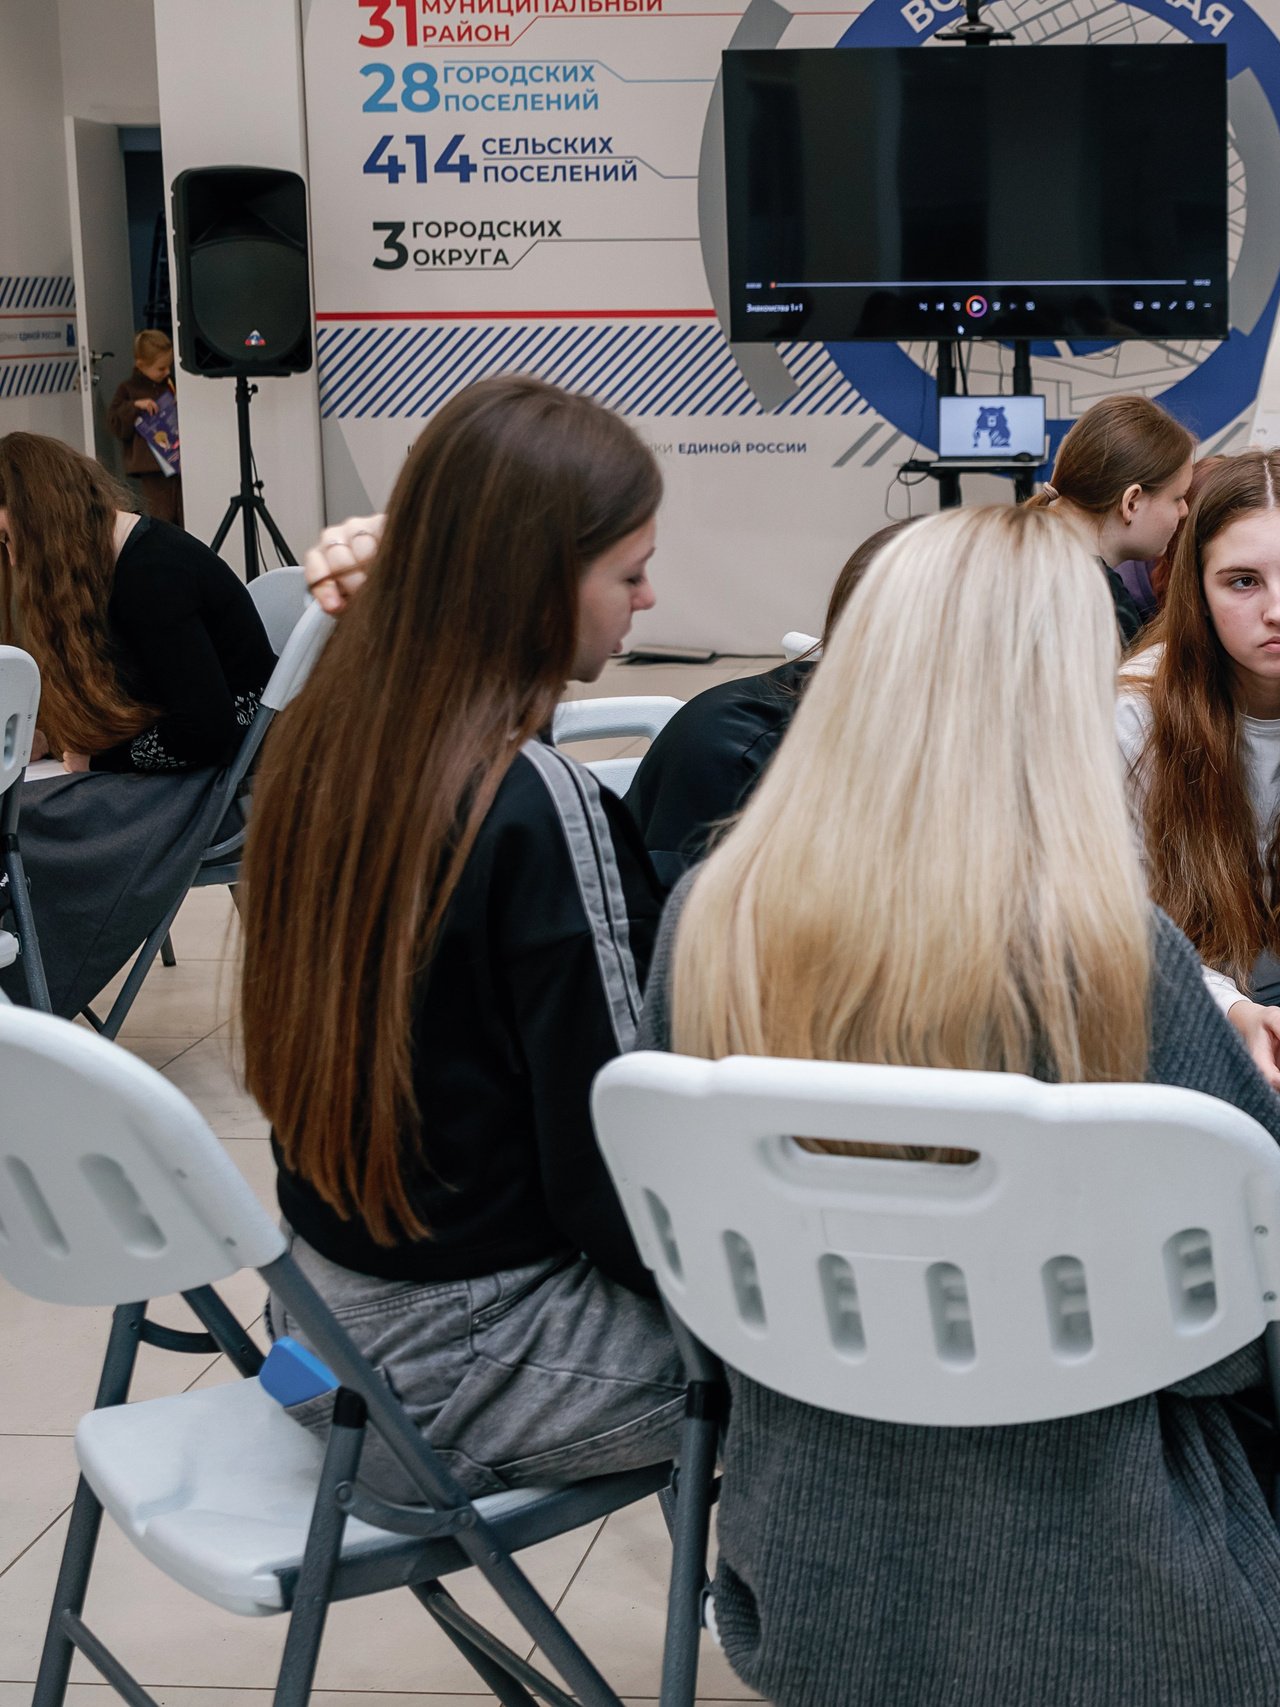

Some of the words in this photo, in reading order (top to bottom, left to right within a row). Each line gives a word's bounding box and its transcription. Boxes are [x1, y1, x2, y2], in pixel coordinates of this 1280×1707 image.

[358, 0, 418, 48] 31
[423, 21, 510, 42] РАЙОН
[443, 64, 596, 86] ГОРОДСКИХ
[359, 62, 441, 113] 28
[444, 89, 599, 112] ПОСЕЛЕНИЙ
[482, 136, 614, 155] СЕЛЬСКИХ
[363, 134, 478, 184] 414
[483, 159, 638, 183] ПОСЕЛЕНИЙ
[412, 220, 562, 241] ГОРОДСКИХ
[372, 222, 409, 270] 3
[413, 248, 510, 267] ОКРУГА
[678, 440, 741, 456] ЕДИНОЙ
[745, 442, 808, 455] РОССИИ
